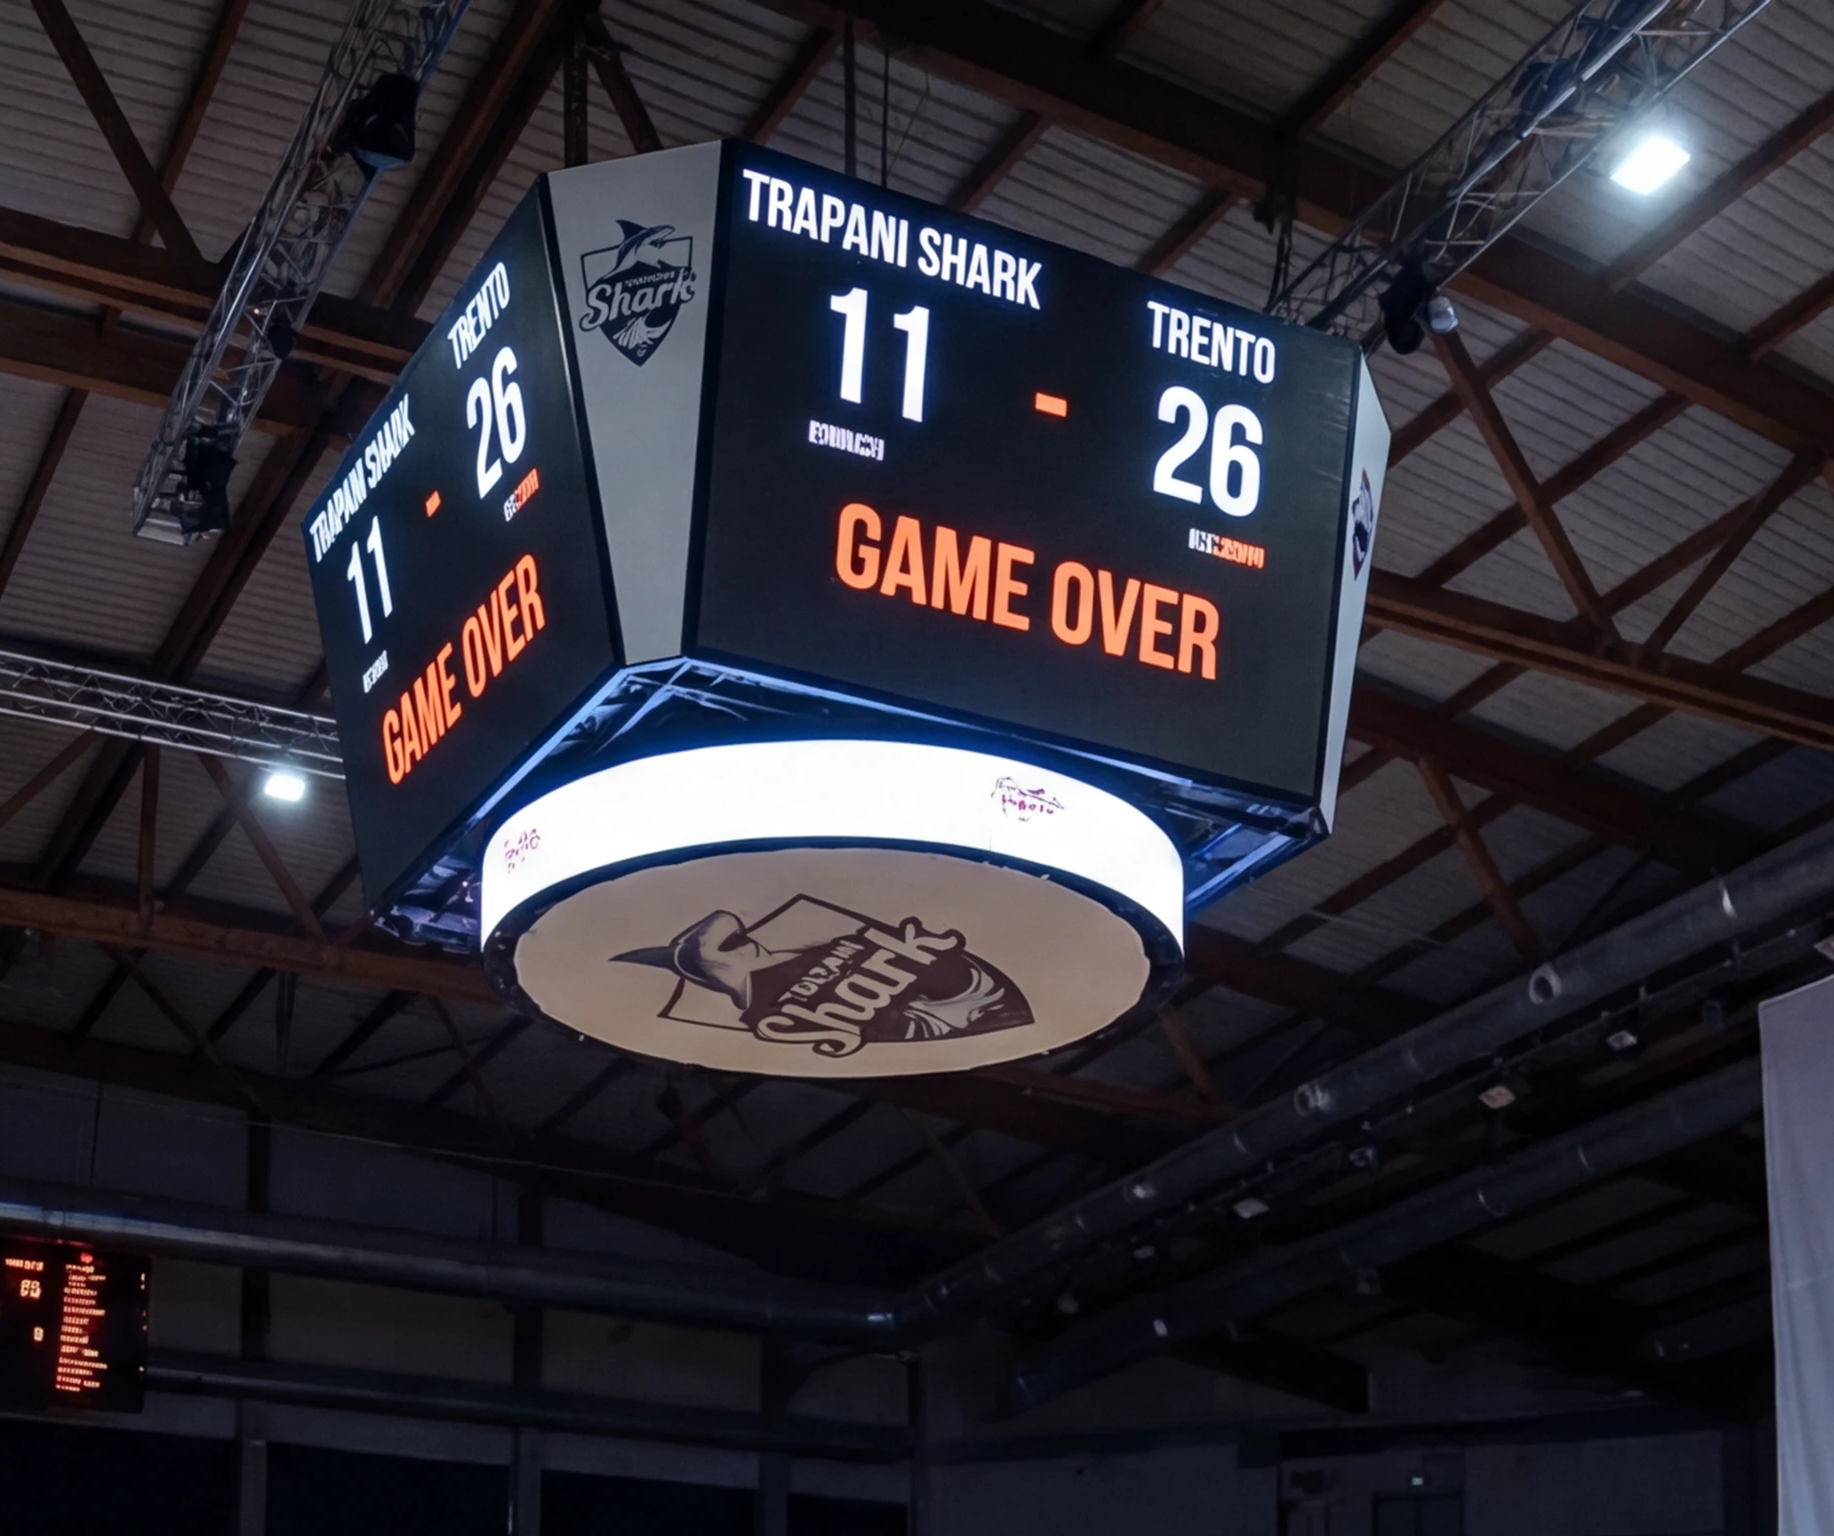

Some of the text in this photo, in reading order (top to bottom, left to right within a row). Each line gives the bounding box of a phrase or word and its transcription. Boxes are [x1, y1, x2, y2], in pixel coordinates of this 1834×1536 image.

[580, 267, 696, 333] Shark
[742, 168, 1043, 310] TRAPANI SHARK
[447, 261, 511, 370] TRENTO
[1146, 301, 1276, 384] TRENTO
[828, 286, 931, 423] 11
[1152, 385, 1264, 518] 26
[346, 515, 394, 644] 11
[466, 346, 526, 499] 26
[836, 503, 1220, 681] GAME OVER
[383, 641, 462, 784] GAME
[463, 554, 546, 698] OVER
[756, 922, 958, 1055] Shark
